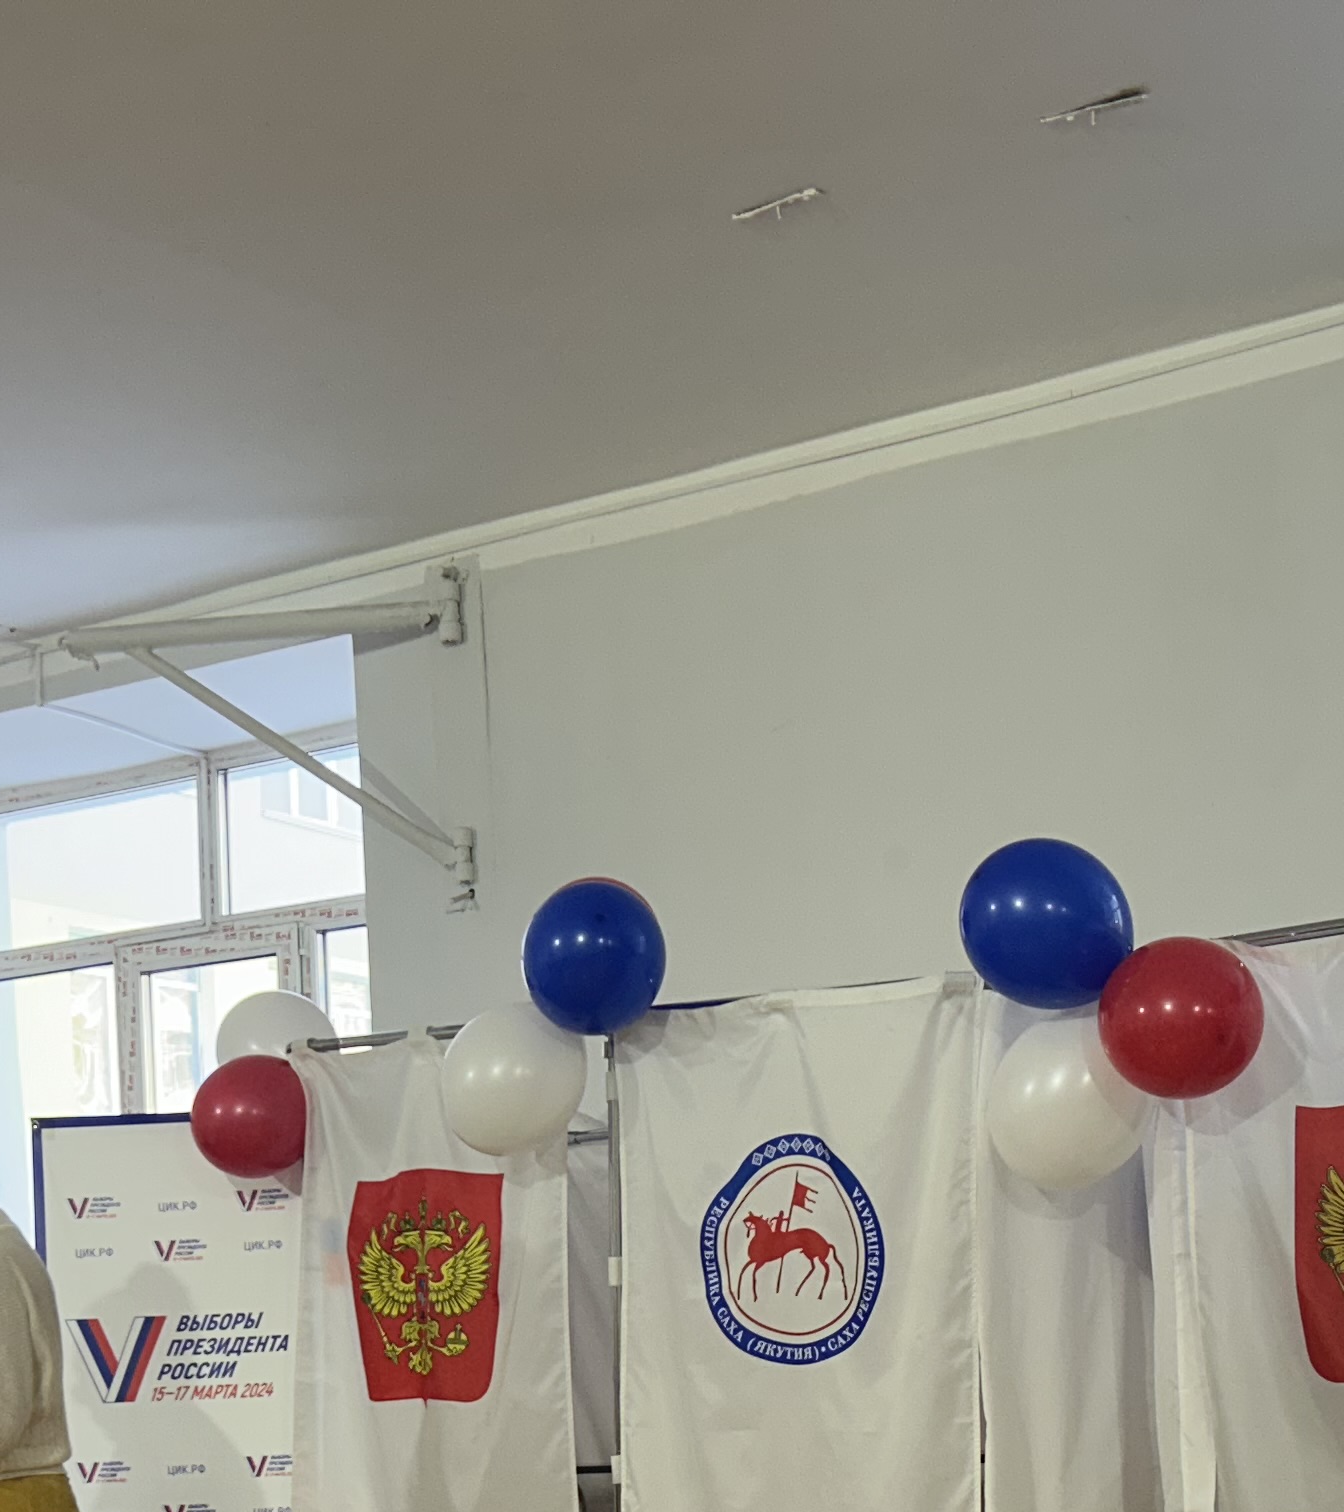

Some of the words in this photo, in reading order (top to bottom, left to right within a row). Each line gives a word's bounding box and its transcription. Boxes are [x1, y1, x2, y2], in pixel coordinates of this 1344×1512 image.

[157, 1201, 198, 1213] ЦИК.РФ
[75, 1247, 114, 1259] ЦИК.РФ
[244, 1240, 283, 1252] ЦИК.РФ
[704, 1196, 730, 1306] РЕСПУБЛИКА
[717, 1307, 743, 1343] САХА
[746, 1337, 819, 1360] (ЯКУТИЯ)
[176, 1312, 264, 1332] ВЫБОРЫ
[166, 1334, 290, 1357] ПРЕЗИДЕНТА
[827, 1322, 860, 1351] САХА
[157, 1361, 237, 1381] РОССИИ
[191, 1384, 239, 1400] МАРТА
[240, 1382, 274, 1399] 2024
[167, 1464, 206, 1476] ЦИК.РФ
